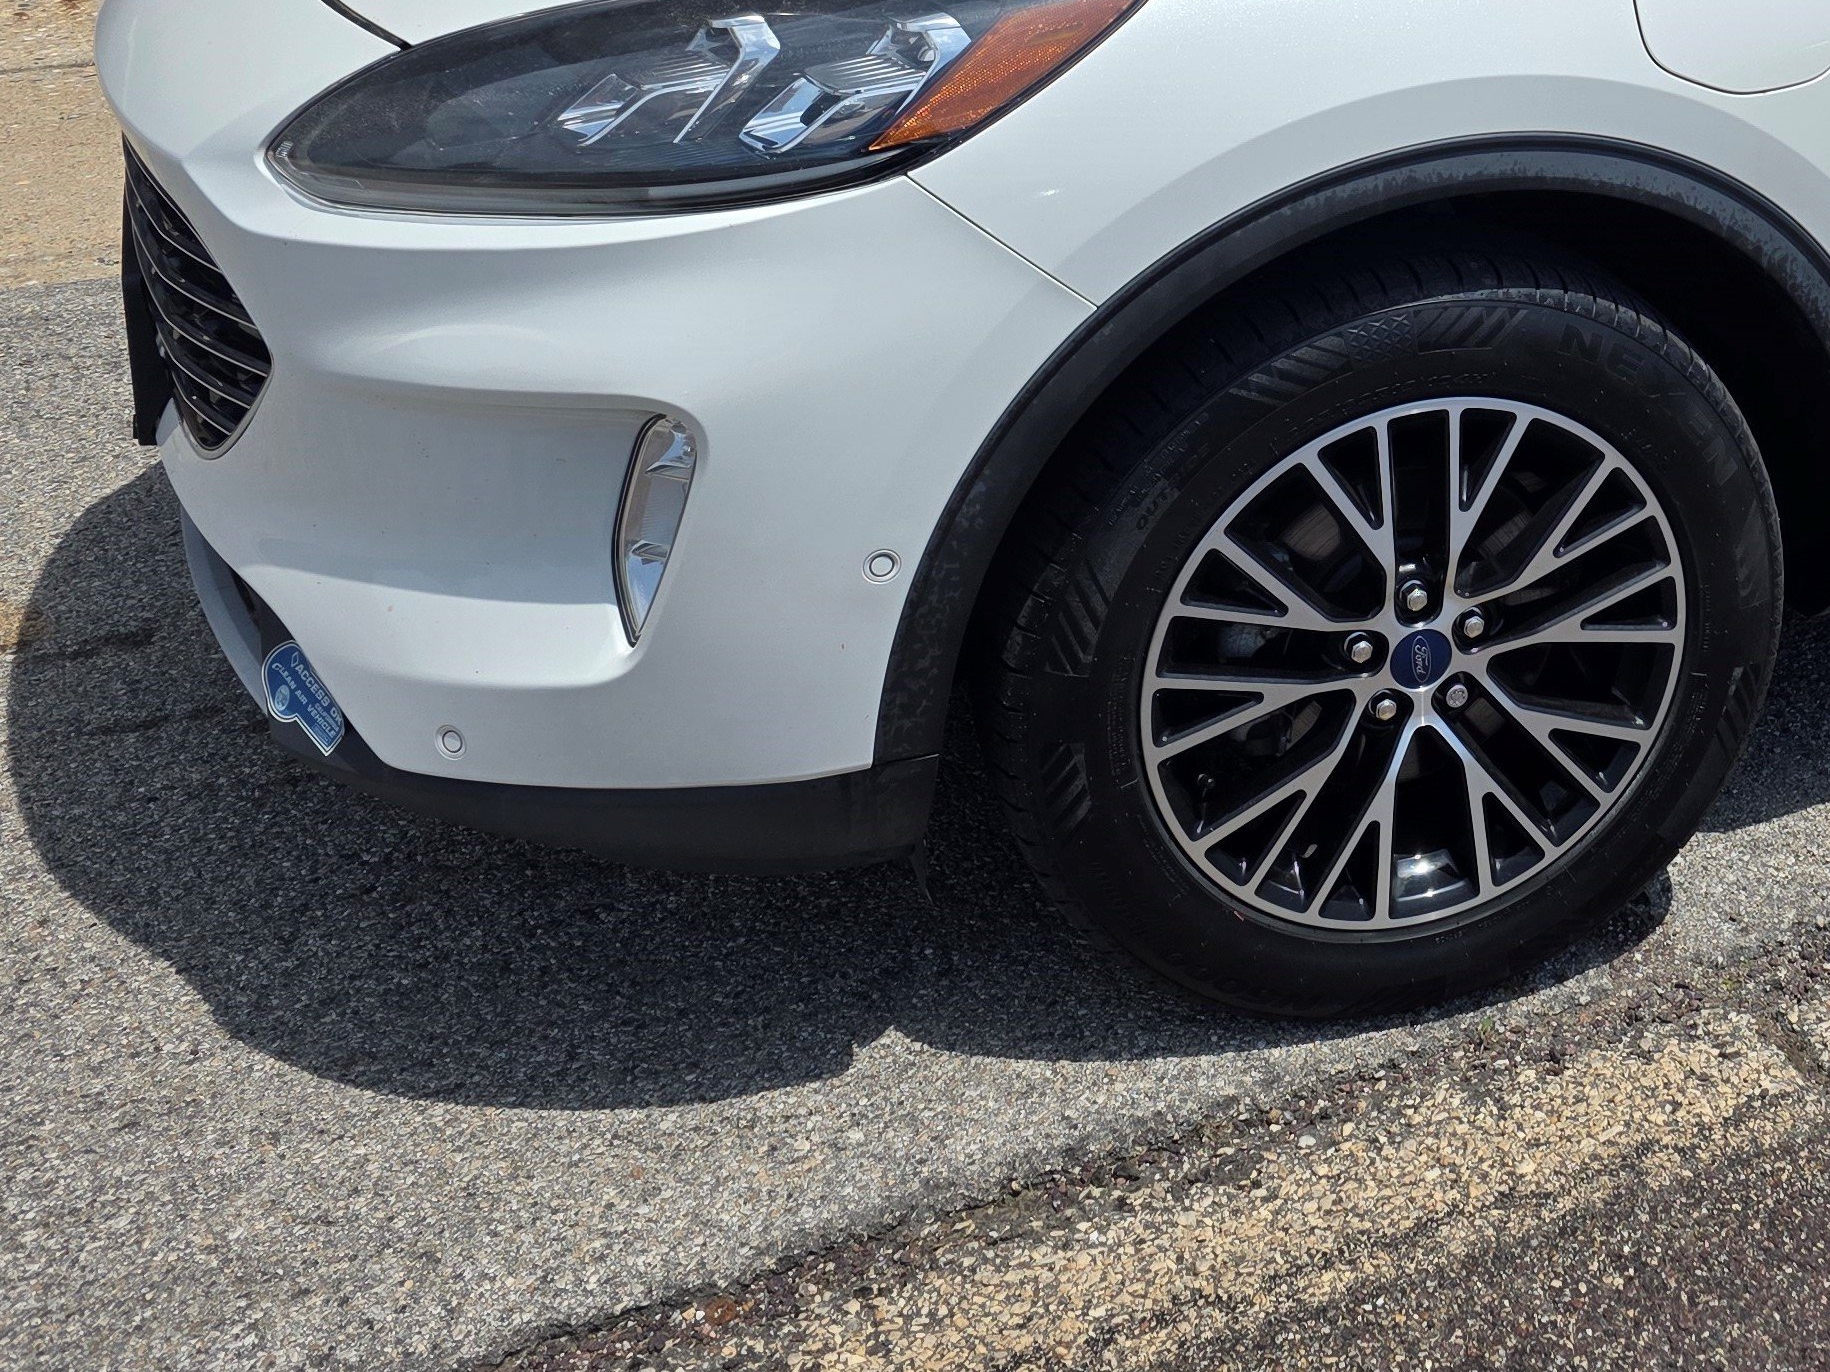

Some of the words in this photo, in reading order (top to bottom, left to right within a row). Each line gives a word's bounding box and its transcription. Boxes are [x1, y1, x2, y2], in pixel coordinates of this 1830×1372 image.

[1415, 644, 1428, 675] Ford
[272, 662, 297, 691] CLEAN
[295, 689, 308, 705] AIR
[307, 704, 336, 737] VEHICLE
[295, 663, 331, 707] ACCESS
